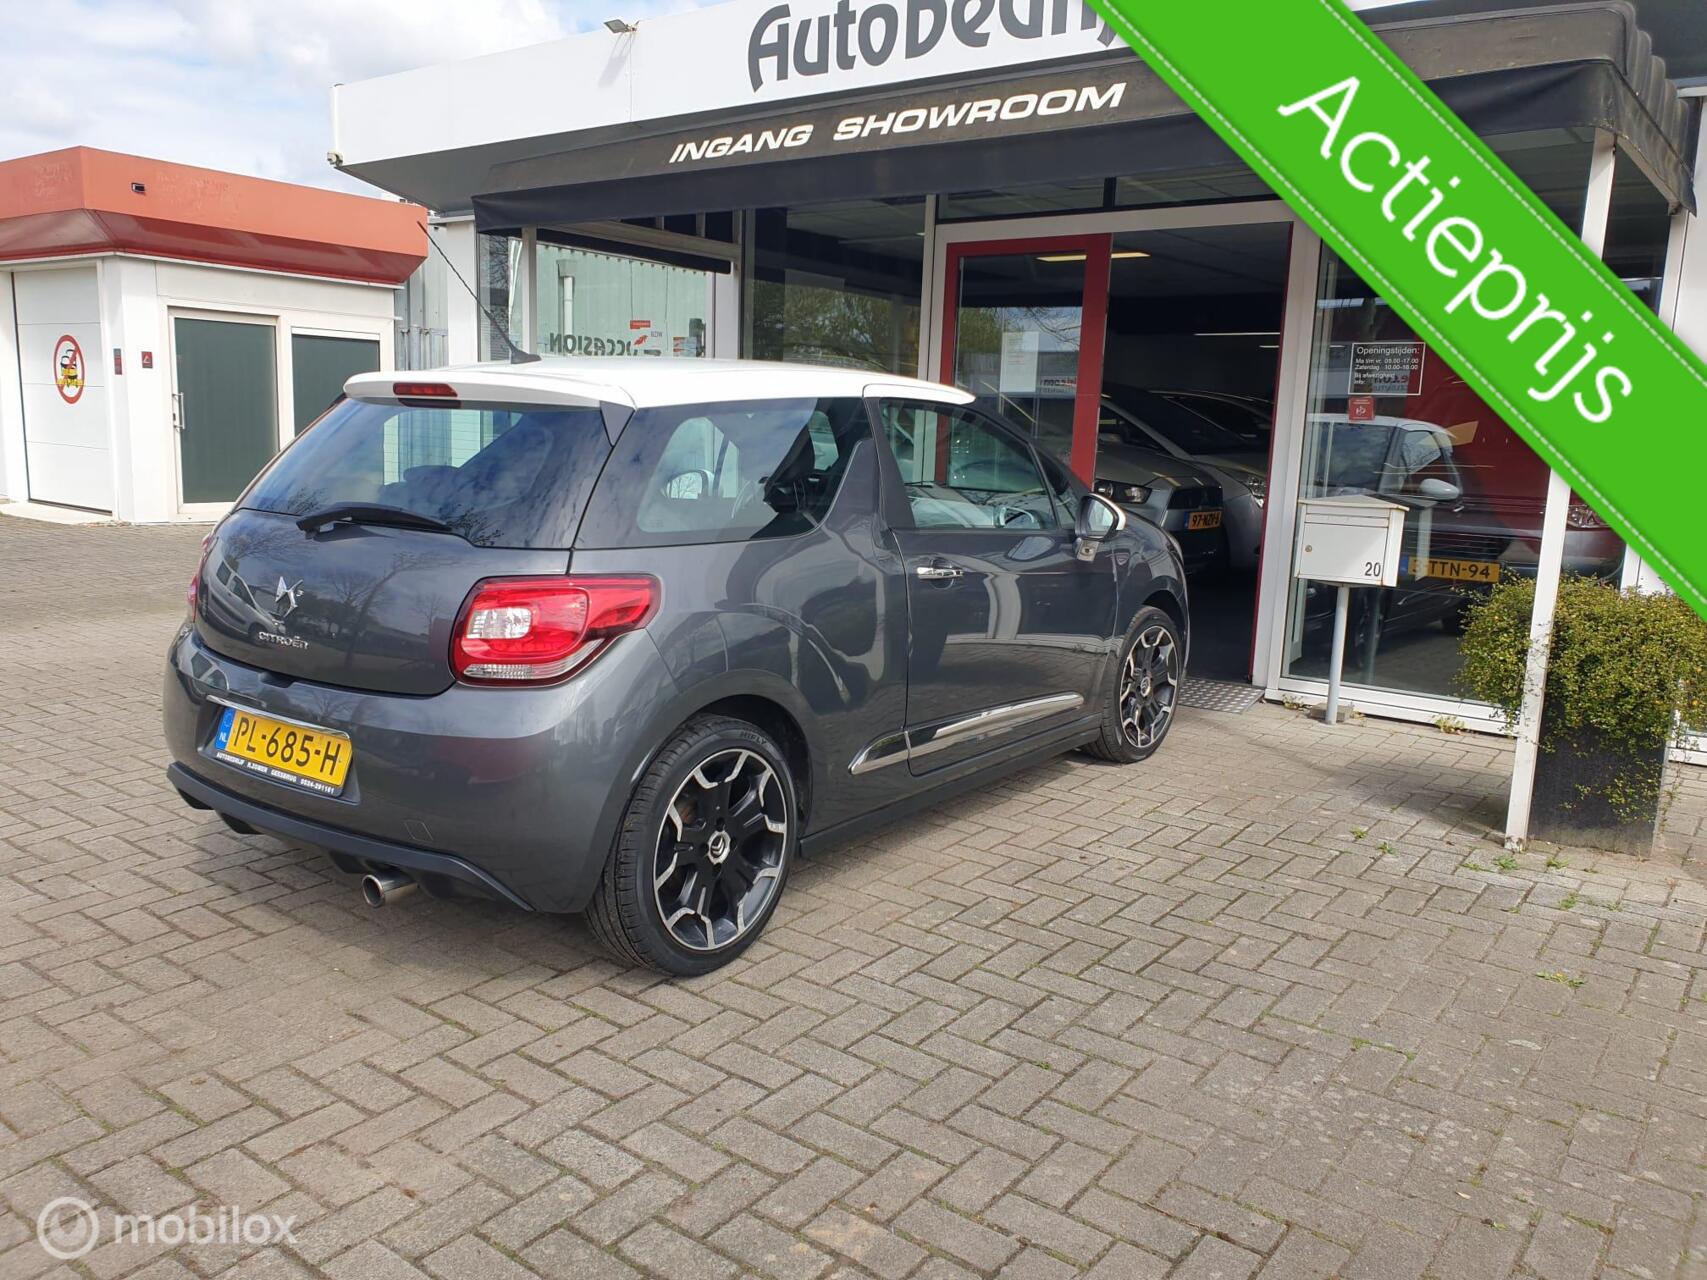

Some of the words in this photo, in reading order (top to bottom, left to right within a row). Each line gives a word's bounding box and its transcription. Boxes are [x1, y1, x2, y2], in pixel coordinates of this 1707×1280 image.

[747, 0, 1118, 93] Autobe
[669, 124, 814, 164] INGANG
[833, 82, 1128, 142] SHOWROOM
[1356, 346, 1420, 356] Openingstijden:
[1364, 561, 1381, 577] 20
[218, 731, 228, 743] NL
[233, 716, 341, 777] PL-685-H
